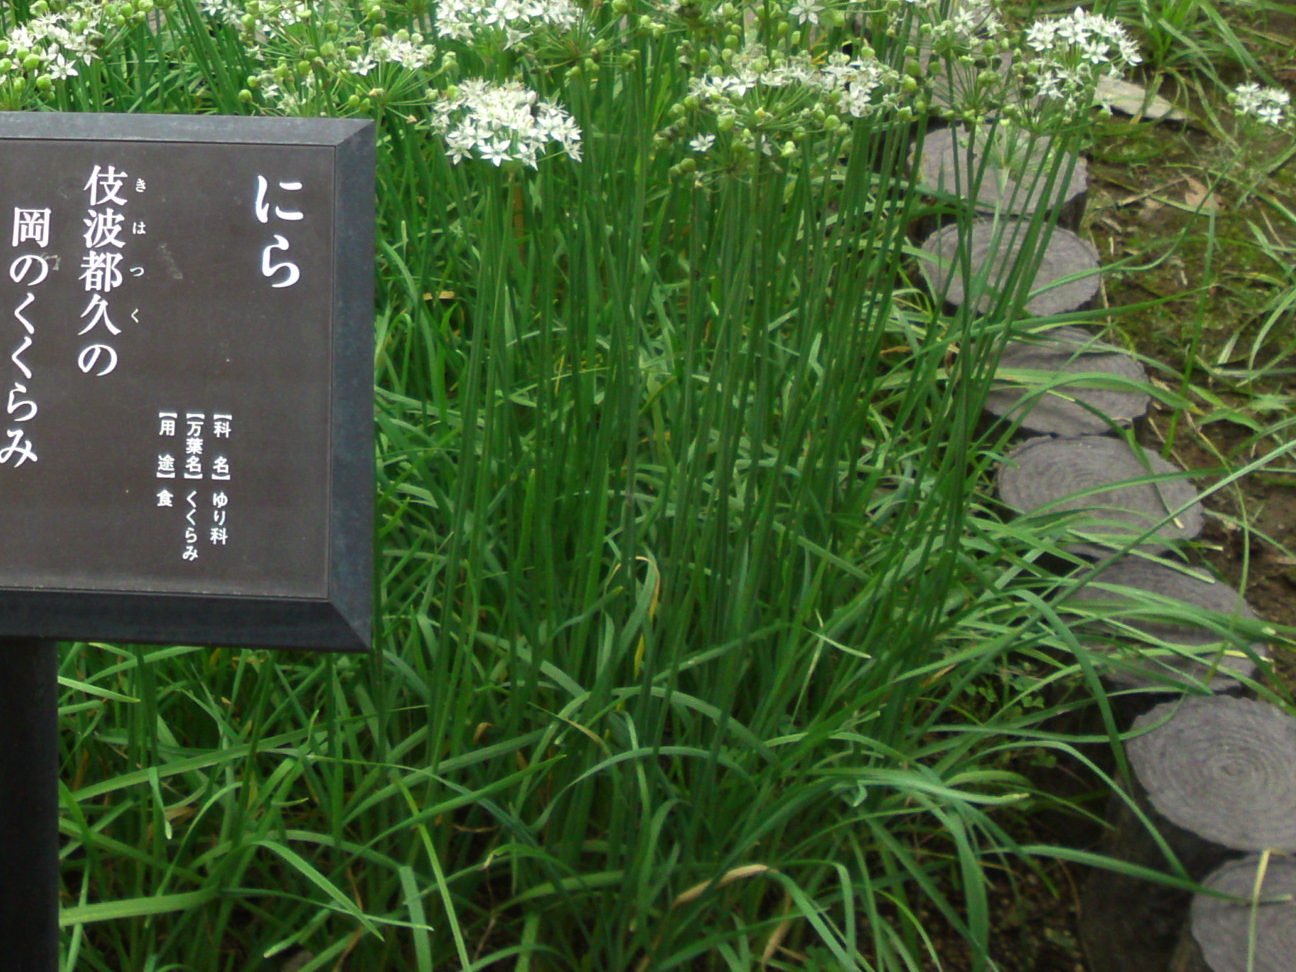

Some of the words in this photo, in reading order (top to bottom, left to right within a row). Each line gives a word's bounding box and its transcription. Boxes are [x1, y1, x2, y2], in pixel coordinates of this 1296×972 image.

[253, 173, 304, 289] にら
[78, 164, 129, 377] 伎波都久の
[156, 488, 174, 508] 食
[182, 489, 199, 562] くくらみ
[209, 491, 229, 546] ゆり科
